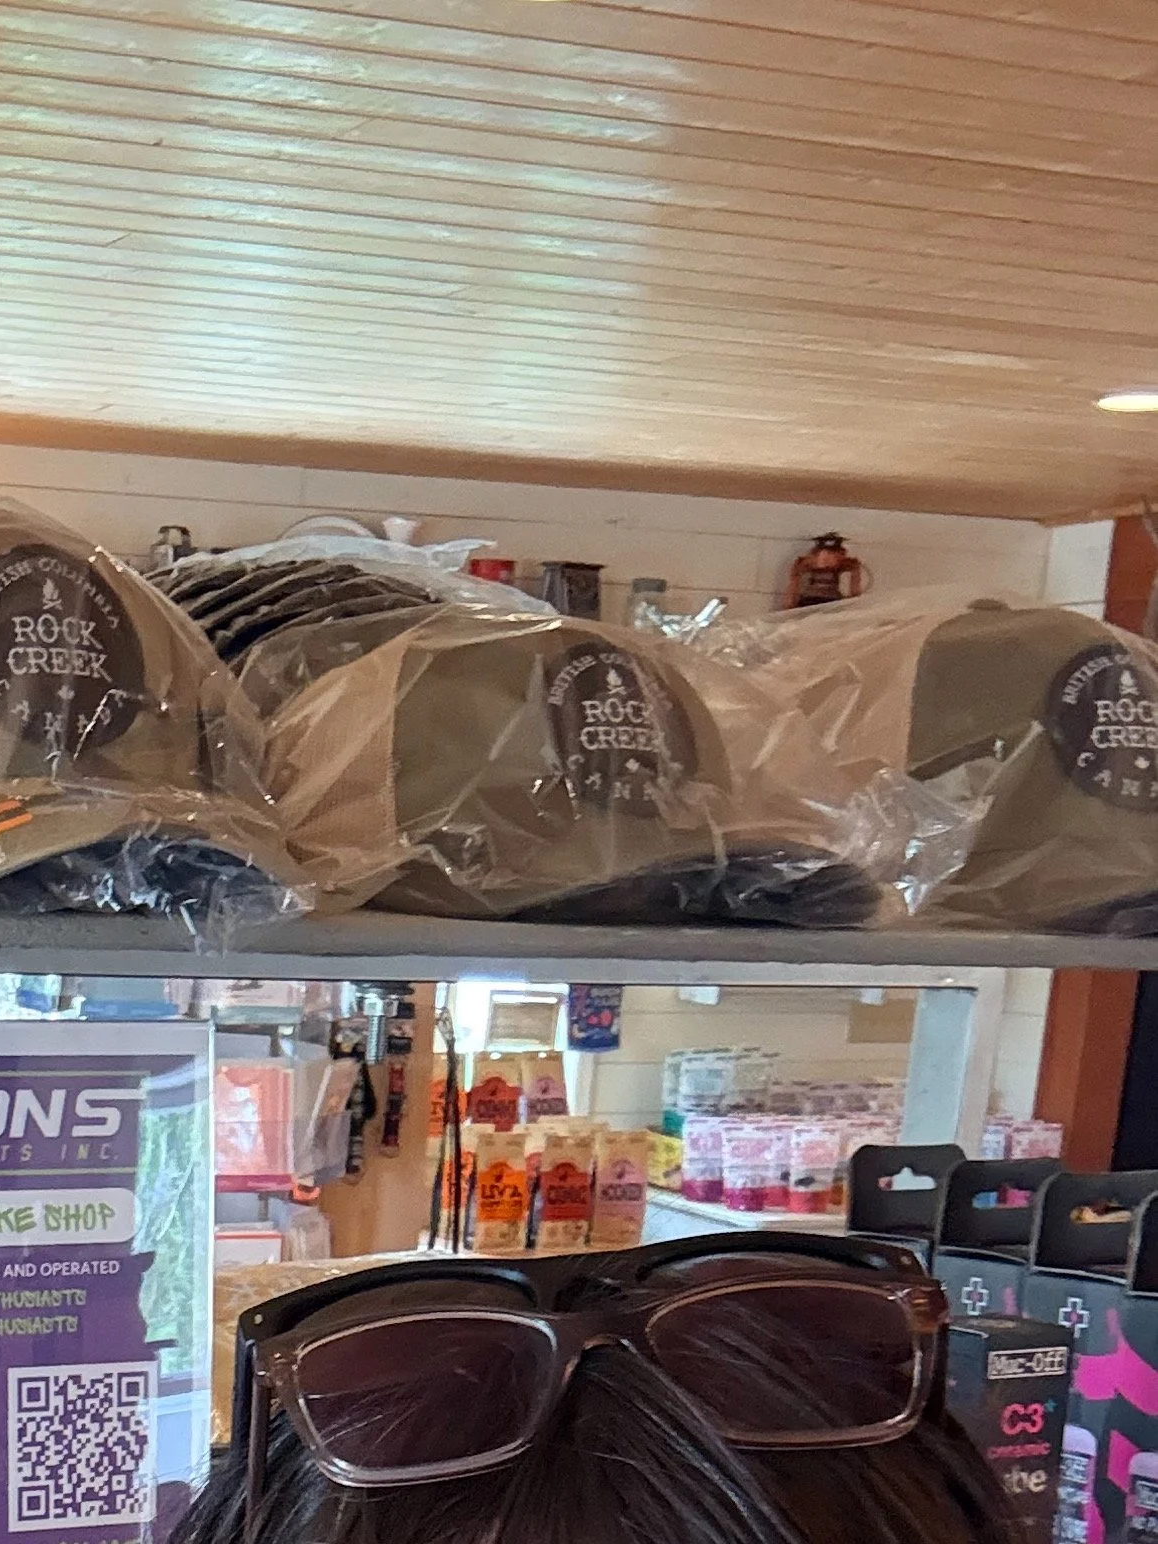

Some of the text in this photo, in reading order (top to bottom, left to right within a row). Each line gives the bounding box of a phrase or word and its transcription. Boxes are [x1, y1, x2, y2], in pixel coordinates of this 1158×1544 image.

[11, 613, 104, 650] ROCK
[6, 646, 113, 683] CREEK
[60, 1142, 119, 1161] INC.
[44, 1202, 116, 1232] SHOP
[3, 1262, 37, 1279] AND
[40, 1259, 120, 1277] OPERATED
[990, 1352, 1066, 1375] Muc-Off
